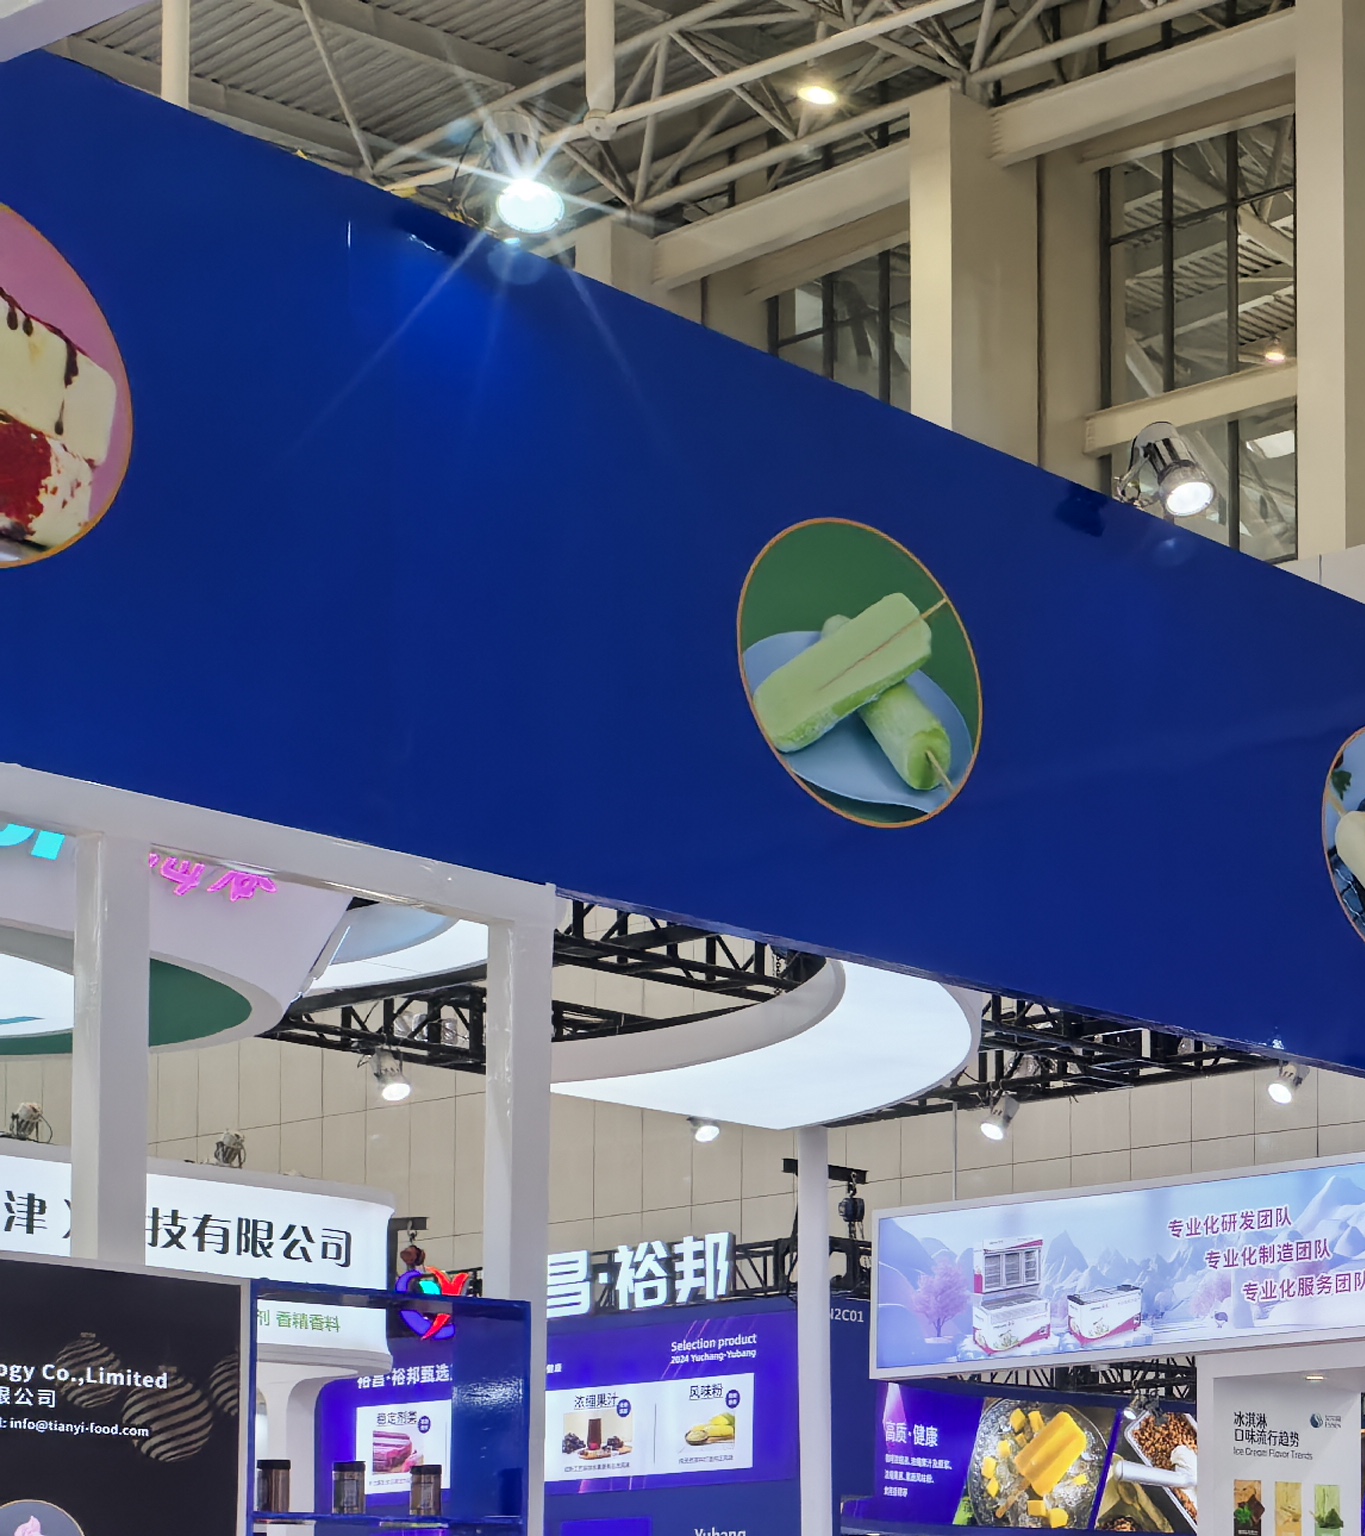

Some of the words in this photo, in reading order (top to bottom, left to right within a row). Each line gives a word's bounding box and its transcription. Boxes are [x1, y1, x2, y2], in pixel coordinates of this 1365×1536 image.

[1168, 1206, 1292, 1238] 专业化研发团队
[1205, 1239, 1331, 1269] 专业化制造团队
[276, 1310, 341, 1333] 香精香料
[671, 1338, 716, 1353] Selection
[718, 1333, 757, 1350] product
[42, 1363, 168, 1389] Co.,Limited
[689, 1383, 724, 1400] 风味粉
[9, 1417, 150, 1438] info@tianyi-food.com
[1233, 1411, 1268, 1428] 冰淇淋
[1234, 1429, 1300, 1448] 口味流行趋势
